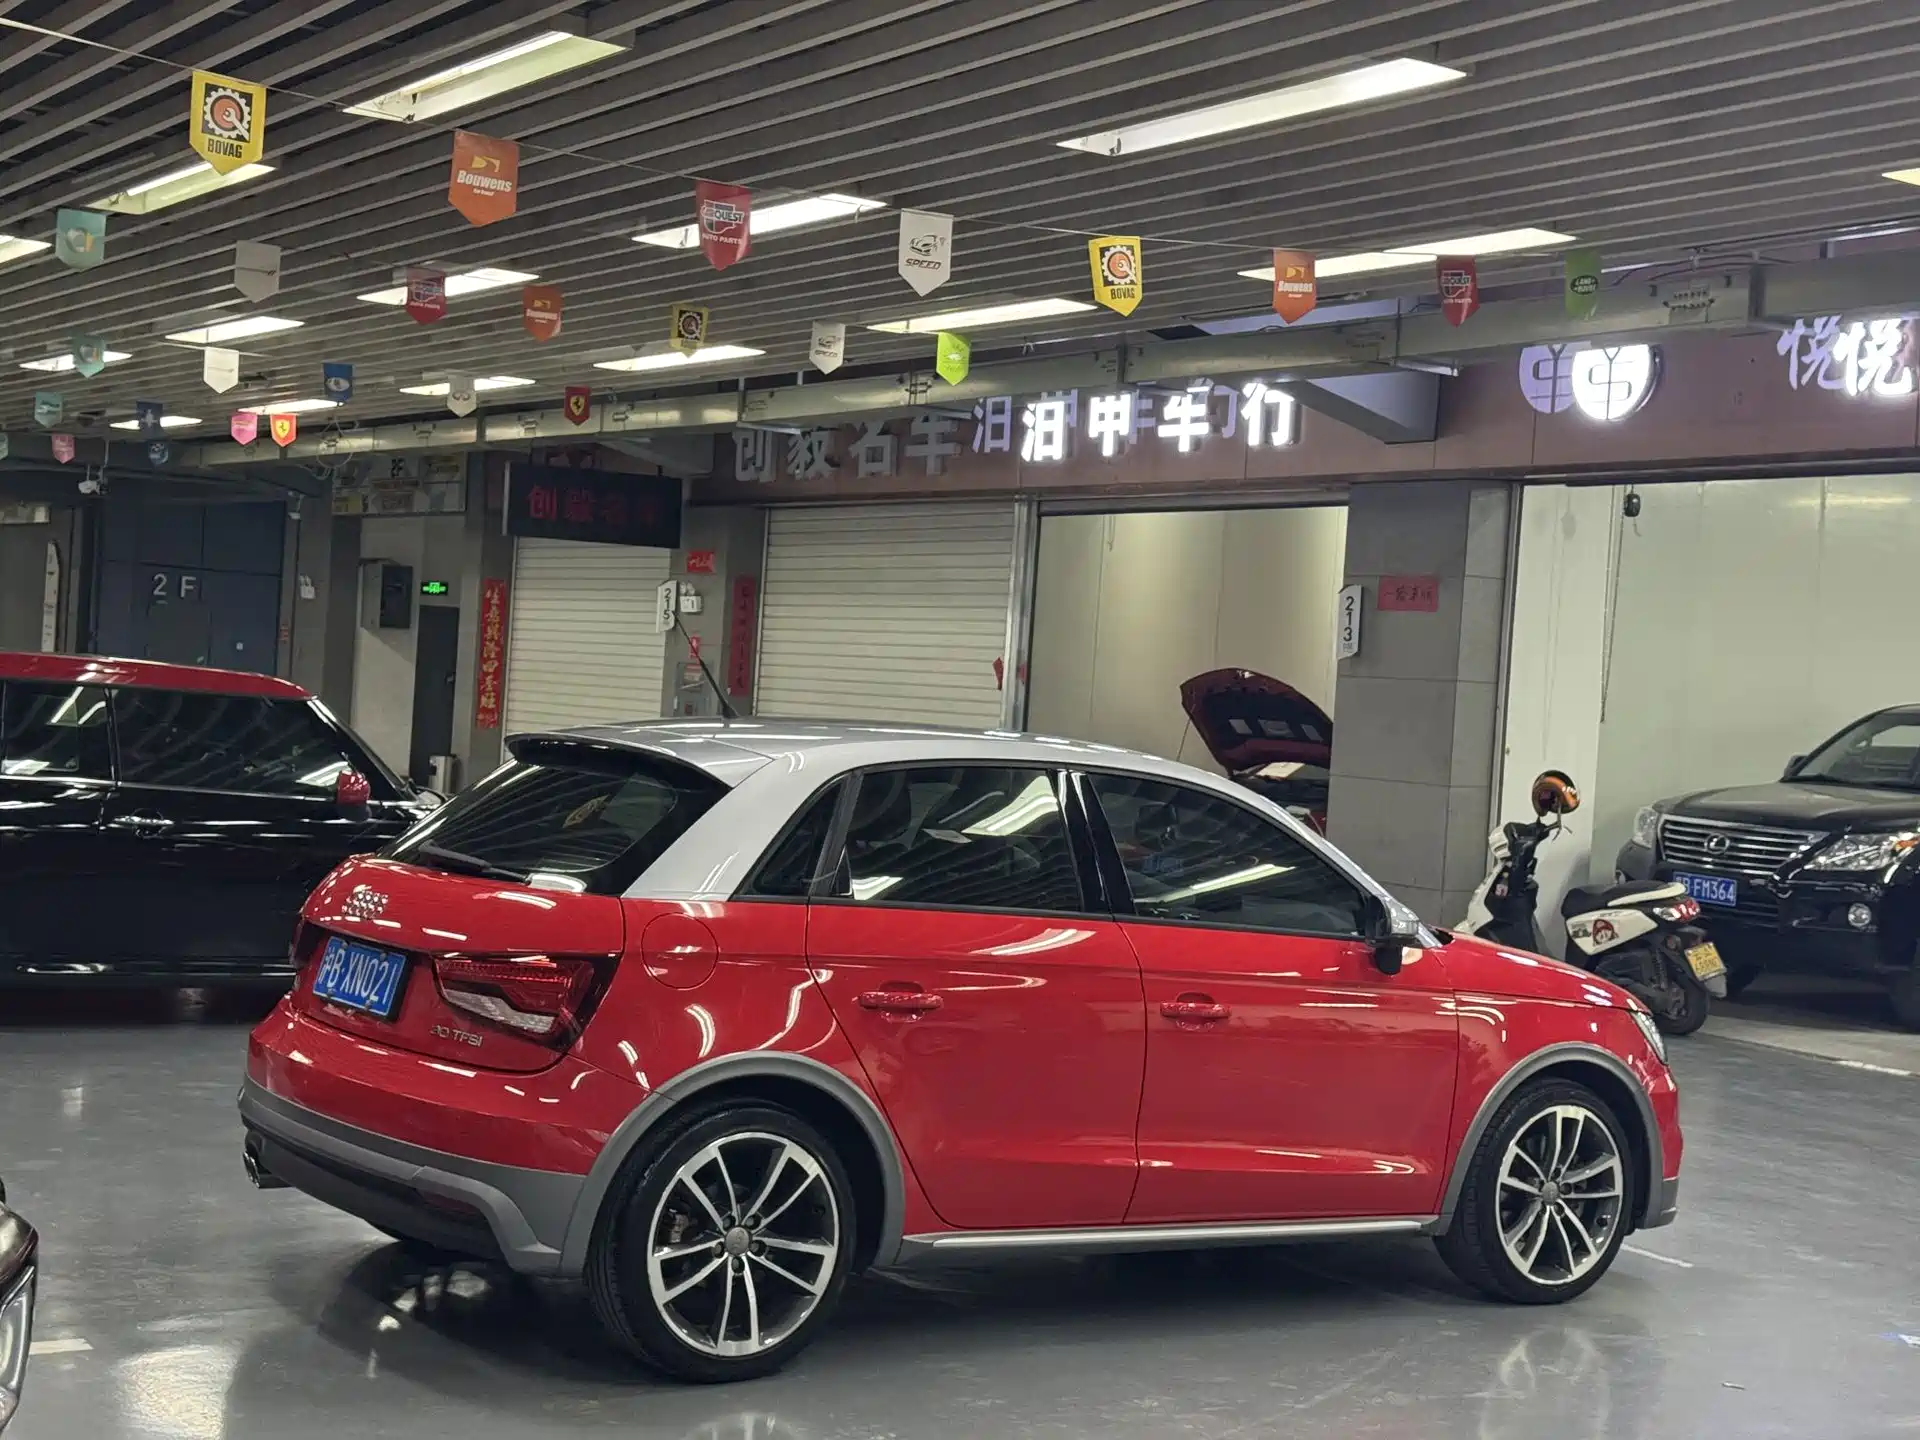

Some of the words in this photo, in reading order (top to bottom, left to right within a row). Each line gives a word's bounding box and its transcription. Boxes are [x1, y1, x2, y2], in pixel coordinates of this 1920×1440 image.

[207, 138, 243, 159] BOVAG
[456, 169, 513, 193] Bouwens
[904, 257, 942, 271] SPEED
[1110, 287, 1136, 300] BOVAG
[1343, 596, 1355, 642] 213
[452, 1029, 483, 1047] TFSI
